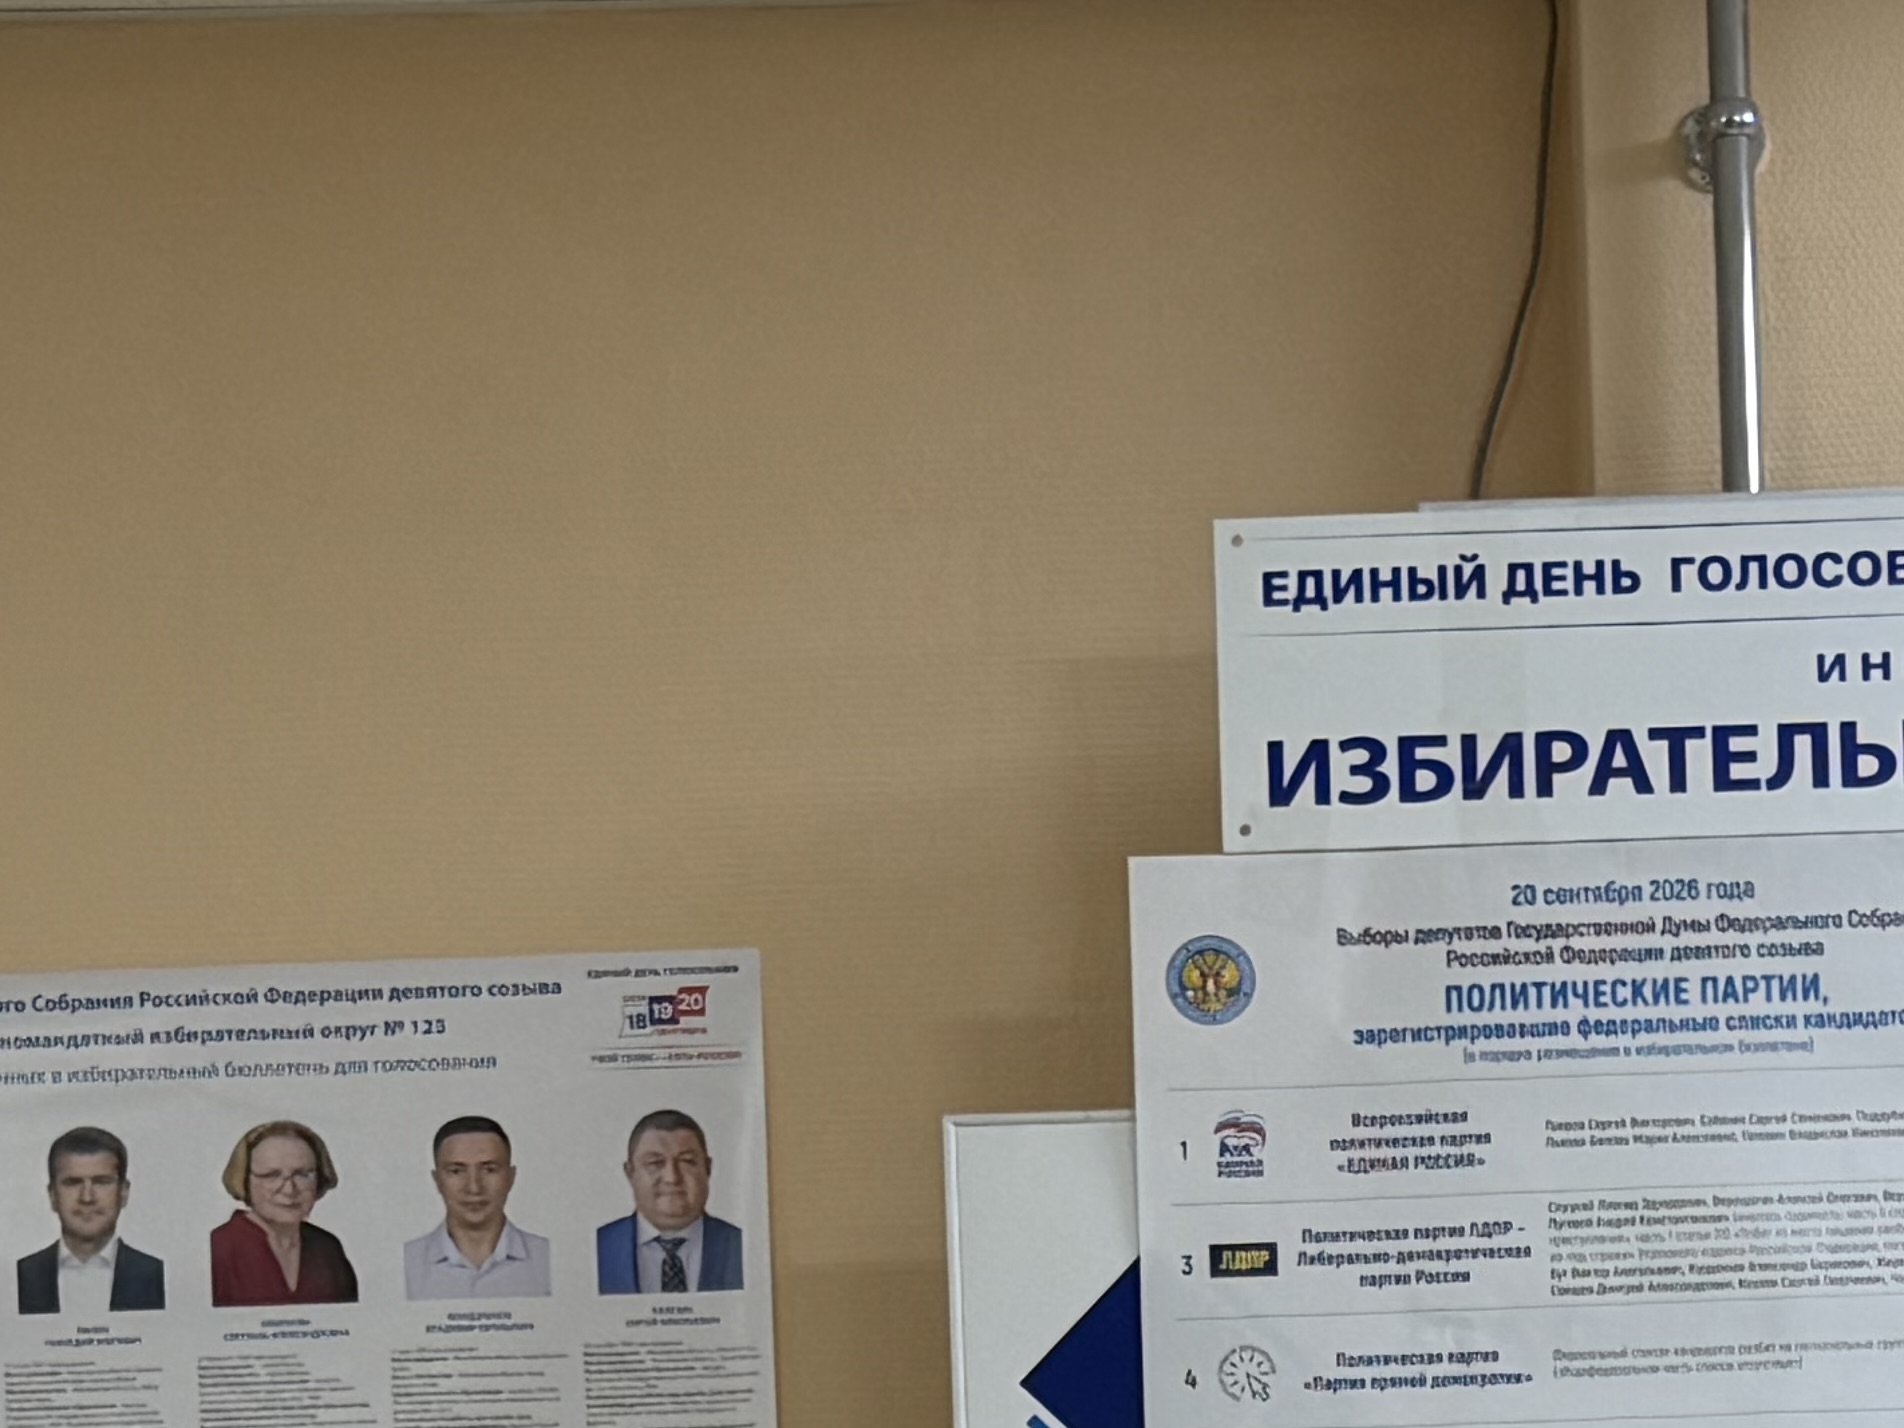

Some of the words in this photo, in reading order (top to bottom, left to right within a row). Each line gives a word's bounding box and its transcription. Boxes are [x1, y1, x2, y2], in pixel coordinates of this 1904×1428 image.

[1262, 553, 1487, 613] ЕДИНЫЙ
[1501, 558, 1641, 606] ДЕНЬ
[1510, 883, 1537, 907] 20
[1542, 880, 1643, 906] сентября
[1649, 878, 1701, 902] 2026
[1706, 880, 1755, 902] года
[1336, 926, 1410, 949] Выборы
[1413, 925, 1503, 946] депутатов
[1506, 916, 1656, 944] Государственной
[1660, 915, 1711, 938] Думы
[1714, 912, 1843, 935] Федерального
[1445, 945, 1555, 969] Российской
[1559, 944, 1665, 966] Федерации
[1669, 943, 1752, 963] девятого
[1756, 941, 1825, 958] созыва
[31, 993, 134, 1014] Собрания
[138, 987, 259, 1009] Российской
[263, 986, 384, 1007] Федерации
[388, 984, 483, 1003] девятого
[486, 981, 562, 997] созыва
[1445, 976, 1690, 1014] ПОЛИТИЧЕСКИЕ
[1701, 972, 1829, 1006] ПАРТИИ,
[627, 1011, 647, 1031] 18
[652, 1002, 673, 1019] 19
[678, 993, 703, 1010] 20
[1353, 1020, 1571, 1048] зарегистрировавшие
[1576, 1015, 1720, 1041] федеральные
[1725, 1014, 1798, 1032] списки
[1181, 1141, 1187, 1160] 1
[1182, 1255, 1193, 1275] 3
[1185, 1369, 1197, 1389] 4
